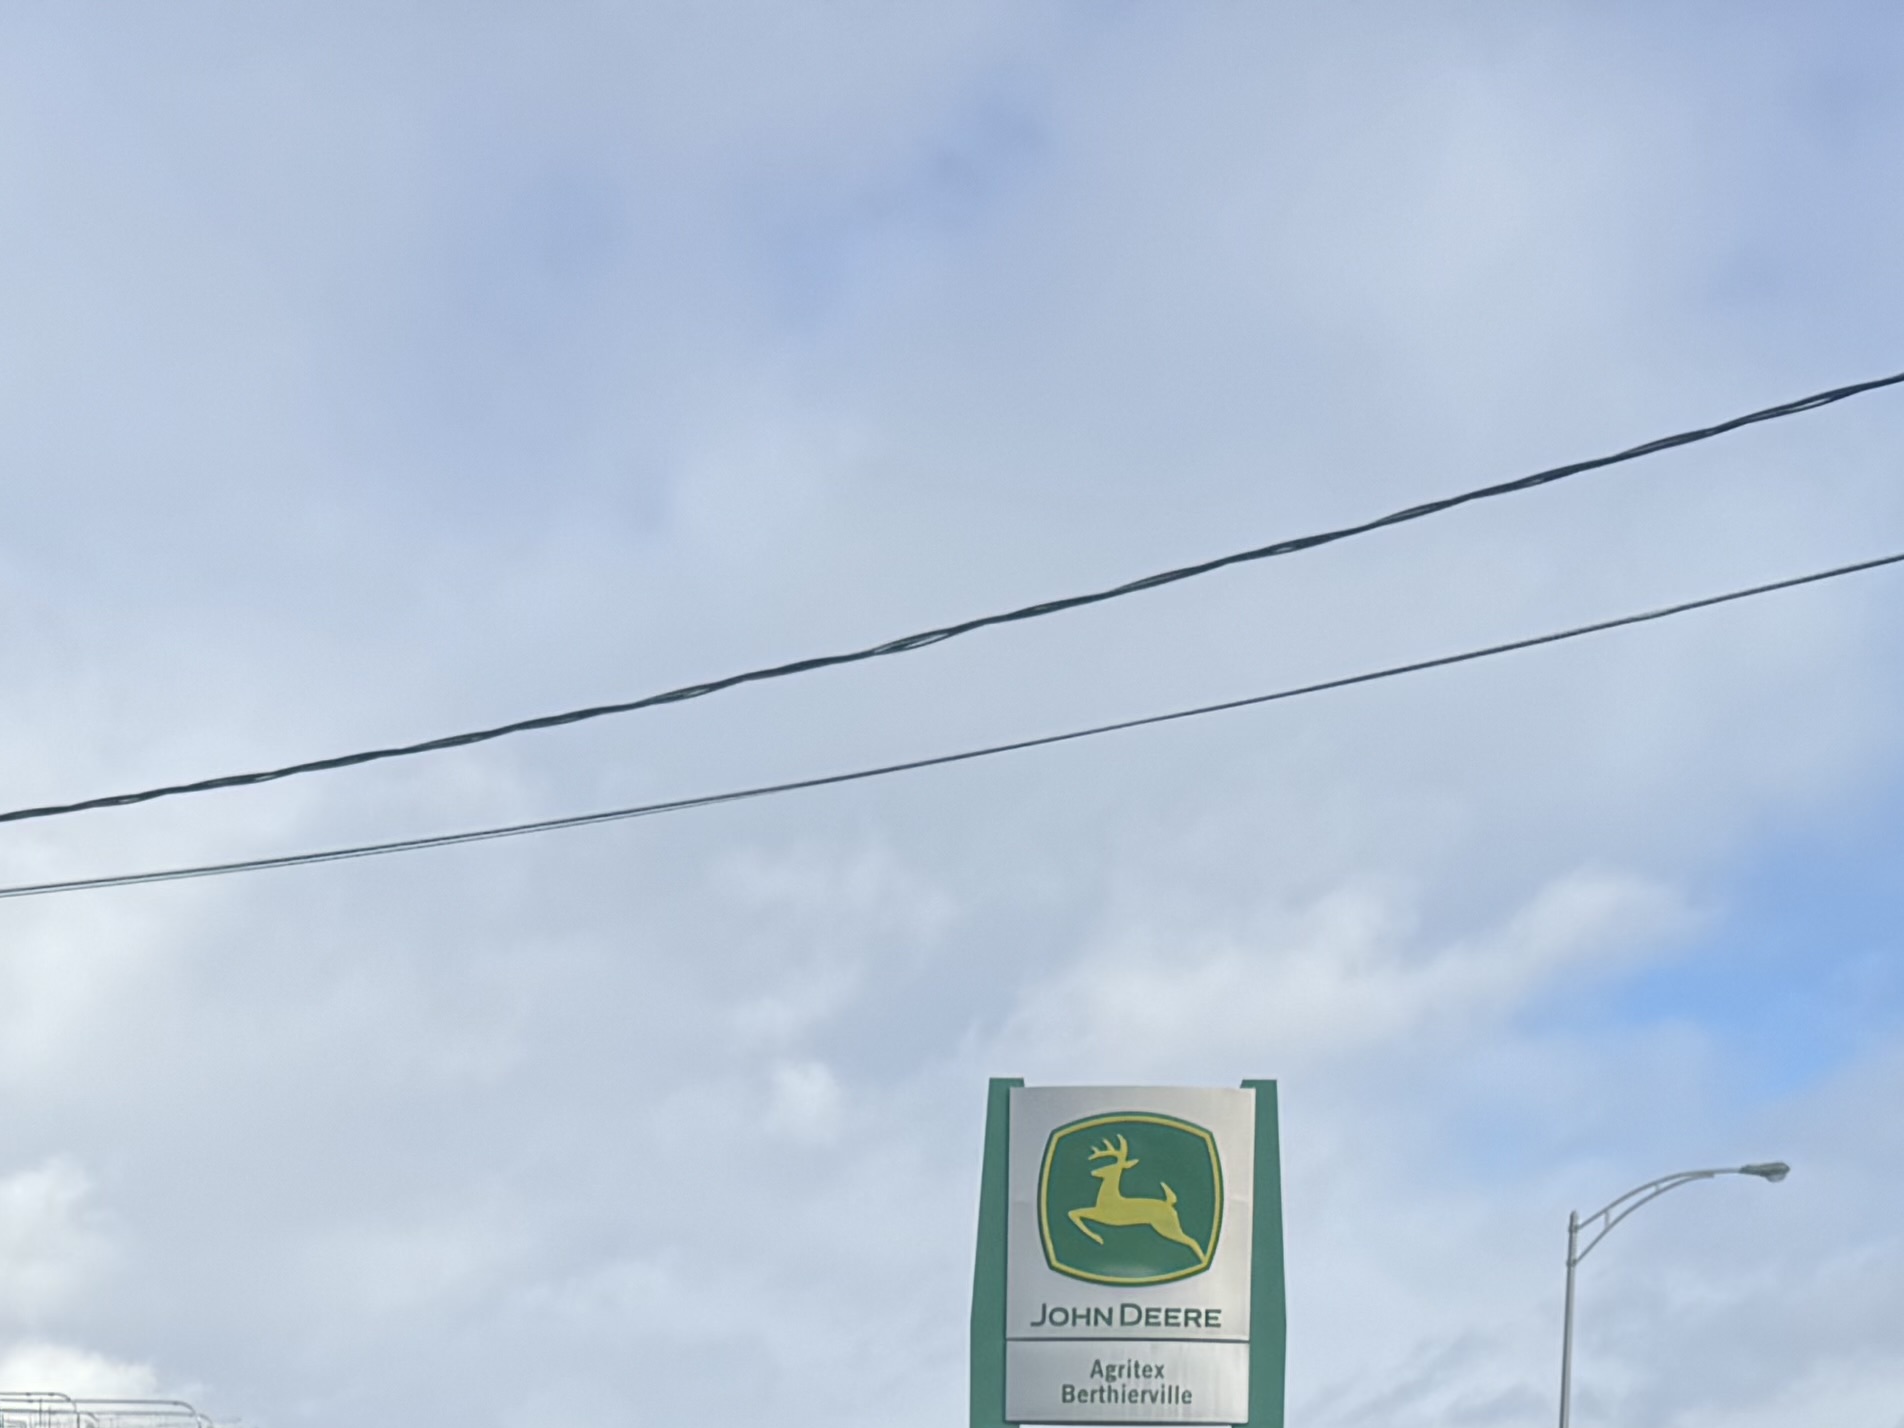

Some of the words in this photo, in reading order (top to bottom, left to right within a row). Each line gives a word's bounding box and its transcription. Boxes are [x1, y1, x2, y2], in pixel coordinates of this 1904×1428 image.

[1029, 1302, 1114, 1328] JOHN
[1119, 1302, 1222, 1328] DEERE
[1089, 1358, 1165, 1382] Agritex
[1061, 1383, 1193, 1405] Berthierville
